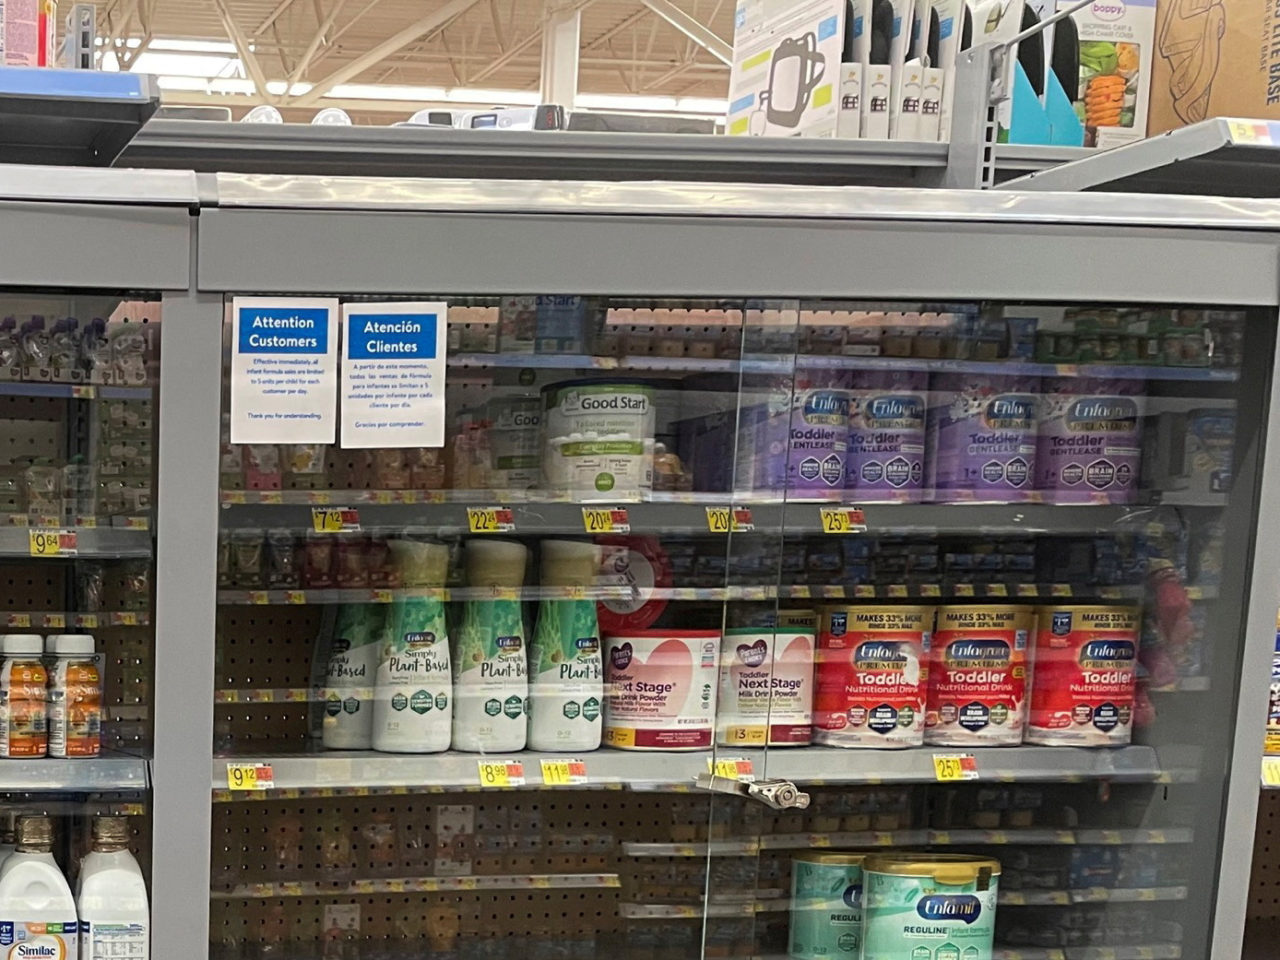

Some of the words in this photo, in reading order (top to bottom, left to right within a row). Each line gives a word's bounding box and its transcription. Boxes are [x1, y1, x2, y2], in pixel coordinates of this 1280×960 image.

[1112, 24, 1127, 32] CART
[252, 316, 314, 328] Attention
[364, 321, 420, 333] Atención
[249, 334, 317, 347] Customers
[366, 340, 417, 352] Clientes
[581, 396, 618, 410] Good
[620, 396, 646, 408] Start
[969, 432, 1020, 446] Toddler
[1050, 434, 1104, 447] Toddler
[946, 613, 974, 622] MAKES
[404, 650, 436, 660] Simply
[946, 671, 1006, 683] Toddler
[739, 678, 768, 688] Next
[771, 678, 802, 691] Stage
[936, 684, 988, 692] Nutritional
[990, 684, 1013, 692] Drink
[774, 690, 798, 698] Powder
[925, 900, 975, 916] Enfamil
[904, 926, 948, 934] REGULINE
[18, 944, 56, 956] Similac
